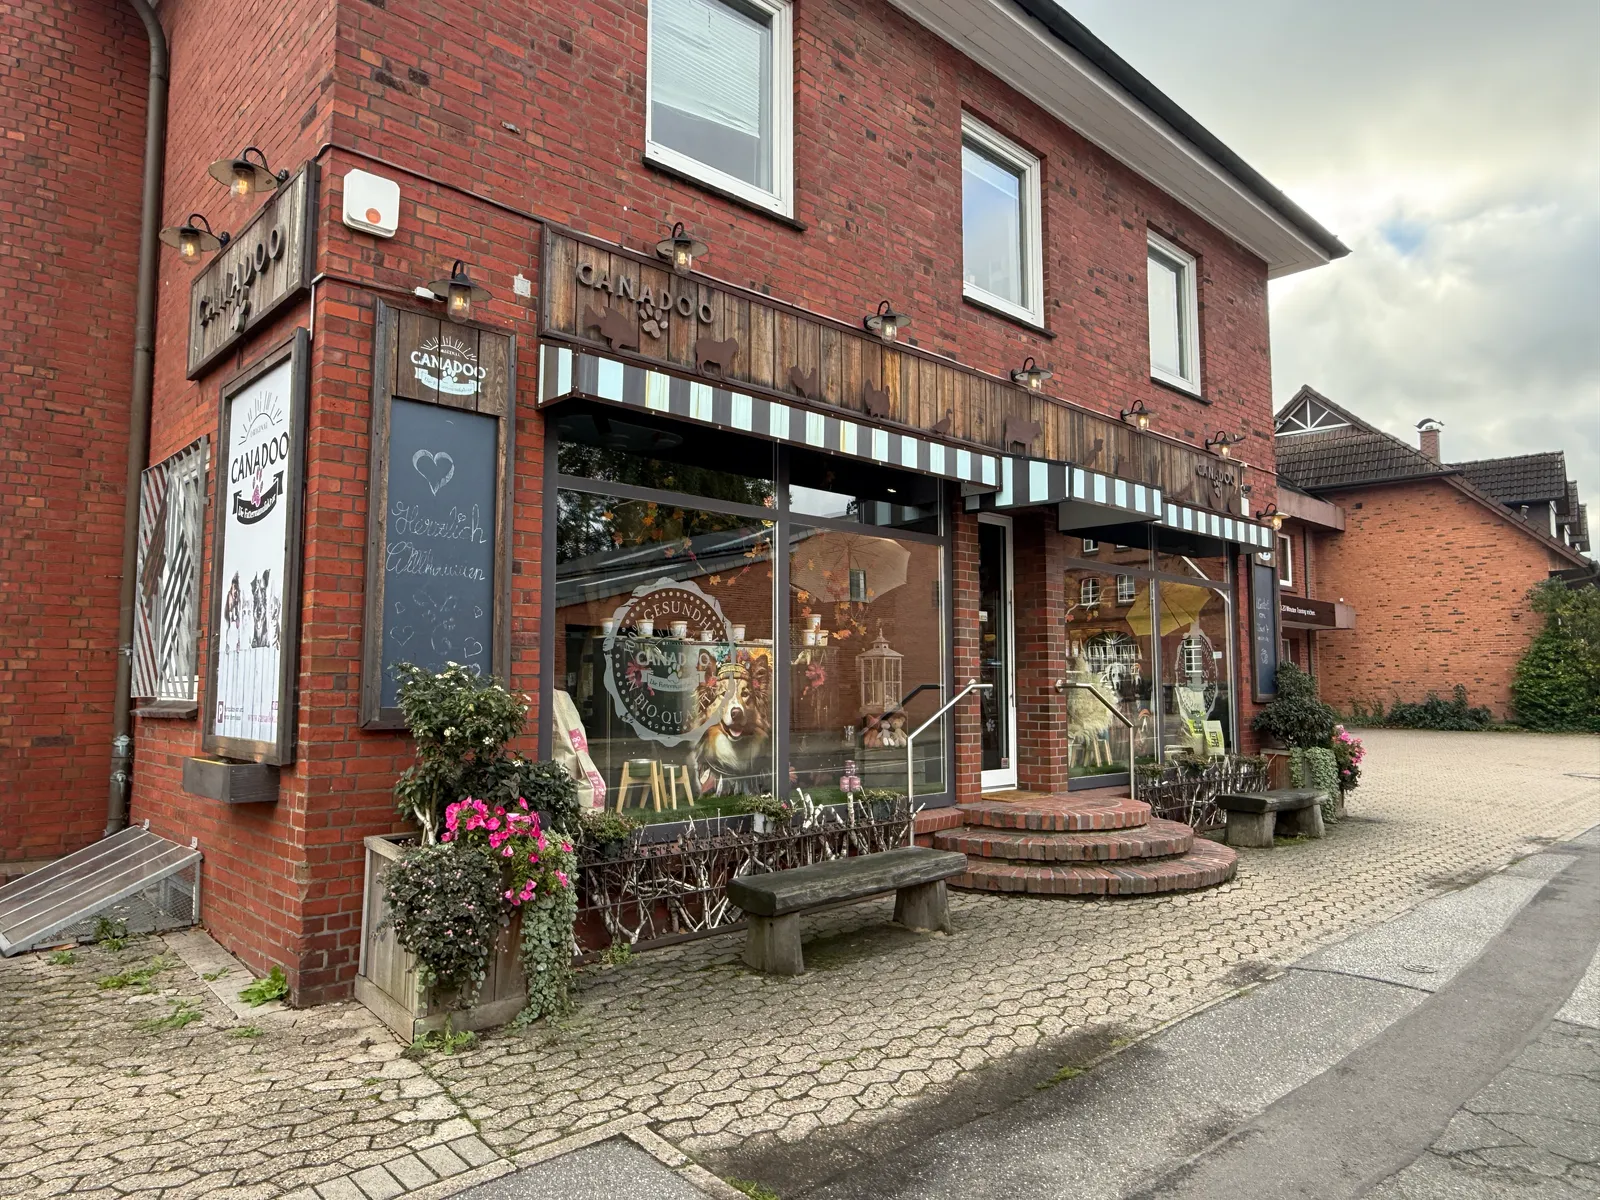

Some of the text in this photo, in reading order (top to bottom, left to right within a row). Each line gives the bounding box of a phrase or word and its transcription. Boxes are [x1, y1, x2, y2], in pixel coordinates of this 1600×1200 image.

[199, 224, 285, 327] CANADOO
[576, 263, 715, 324] CANADOO
[410, 351, 486, 379] CANADOO
[231, 431, 289, 484] CANADOO
[391, 501, 487, 544] Herzlich
